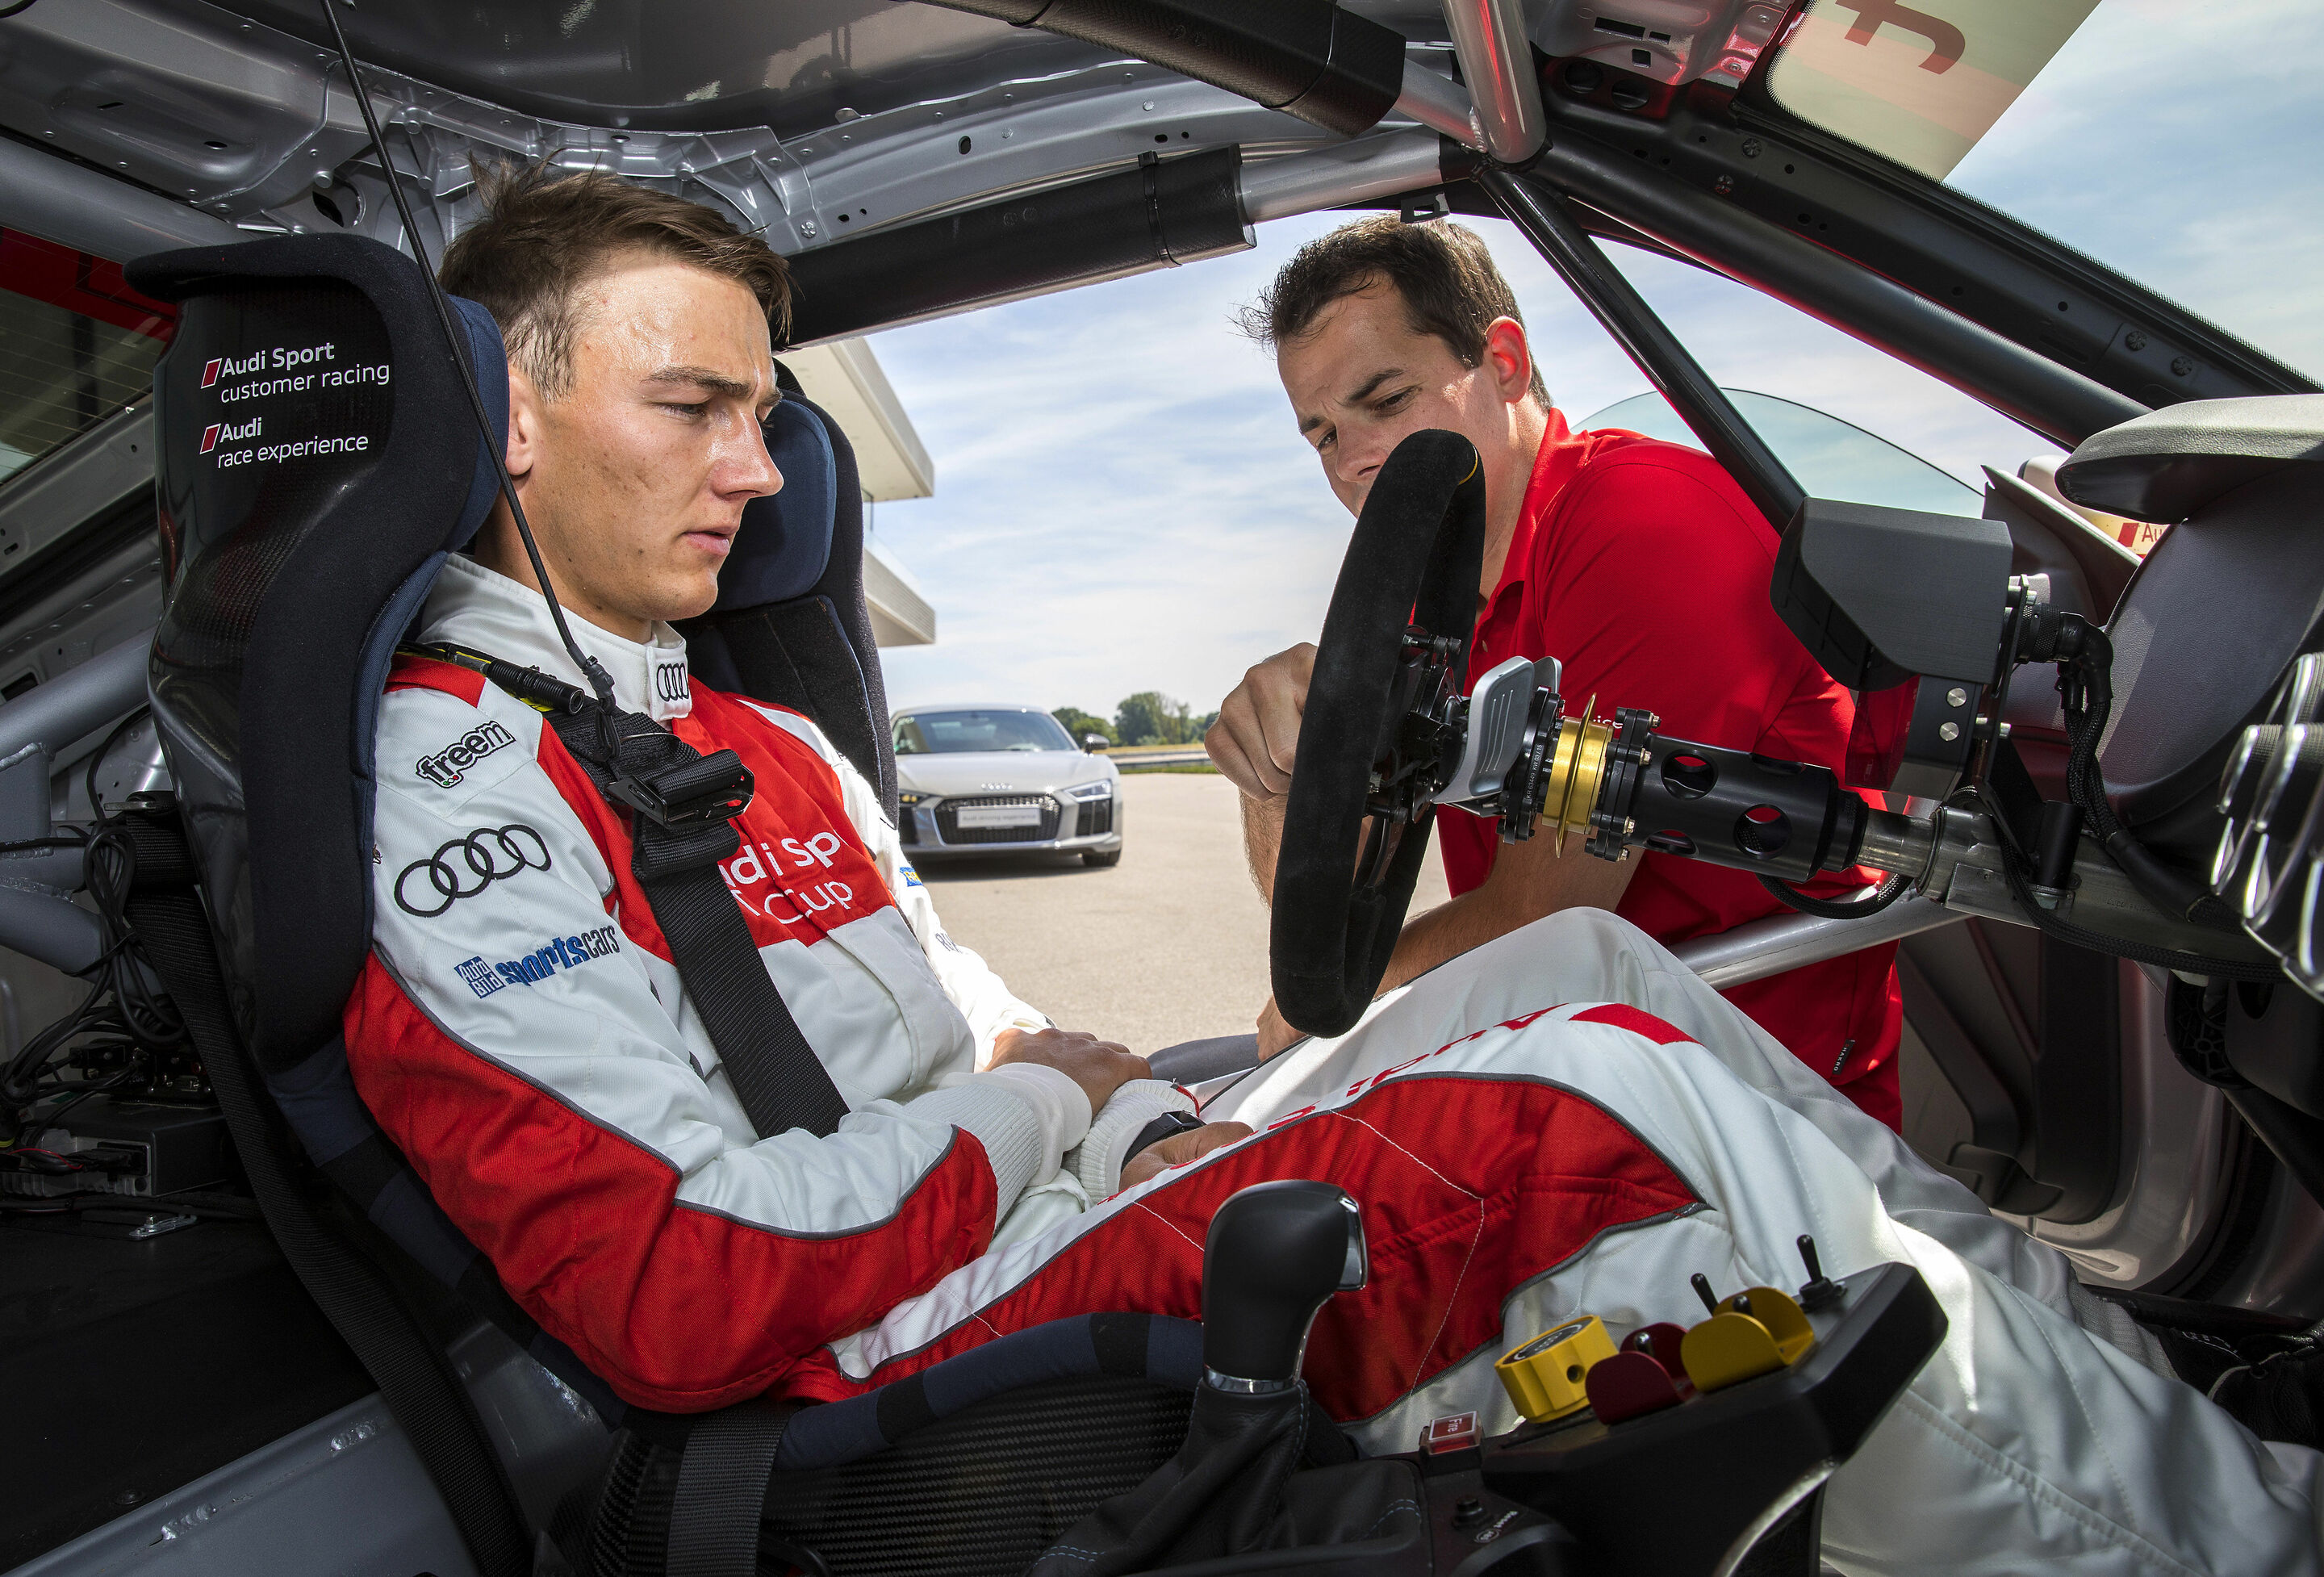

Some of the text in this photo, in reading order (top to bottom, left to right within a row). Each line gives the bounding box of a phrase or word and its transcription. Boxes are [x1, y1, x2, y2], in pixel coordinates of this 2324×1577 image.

[221, 342, 335, 378] Audi Sport
[220, 363, 391, 404] customer racing
[219, 417, 262, 443] Audi
[217, 435, 369, 469] race experience
[2141, 523, 2163, 542] Au
[420, 722, 512, 783] freem
[781, 830, 847, 868] Sp
[764, 881, 854, 925] Cup
[458, 958, 492, 984] Auto
[470, 971, 504, 998] Bild
[1447, 1417, 1463, 1433] Fire
